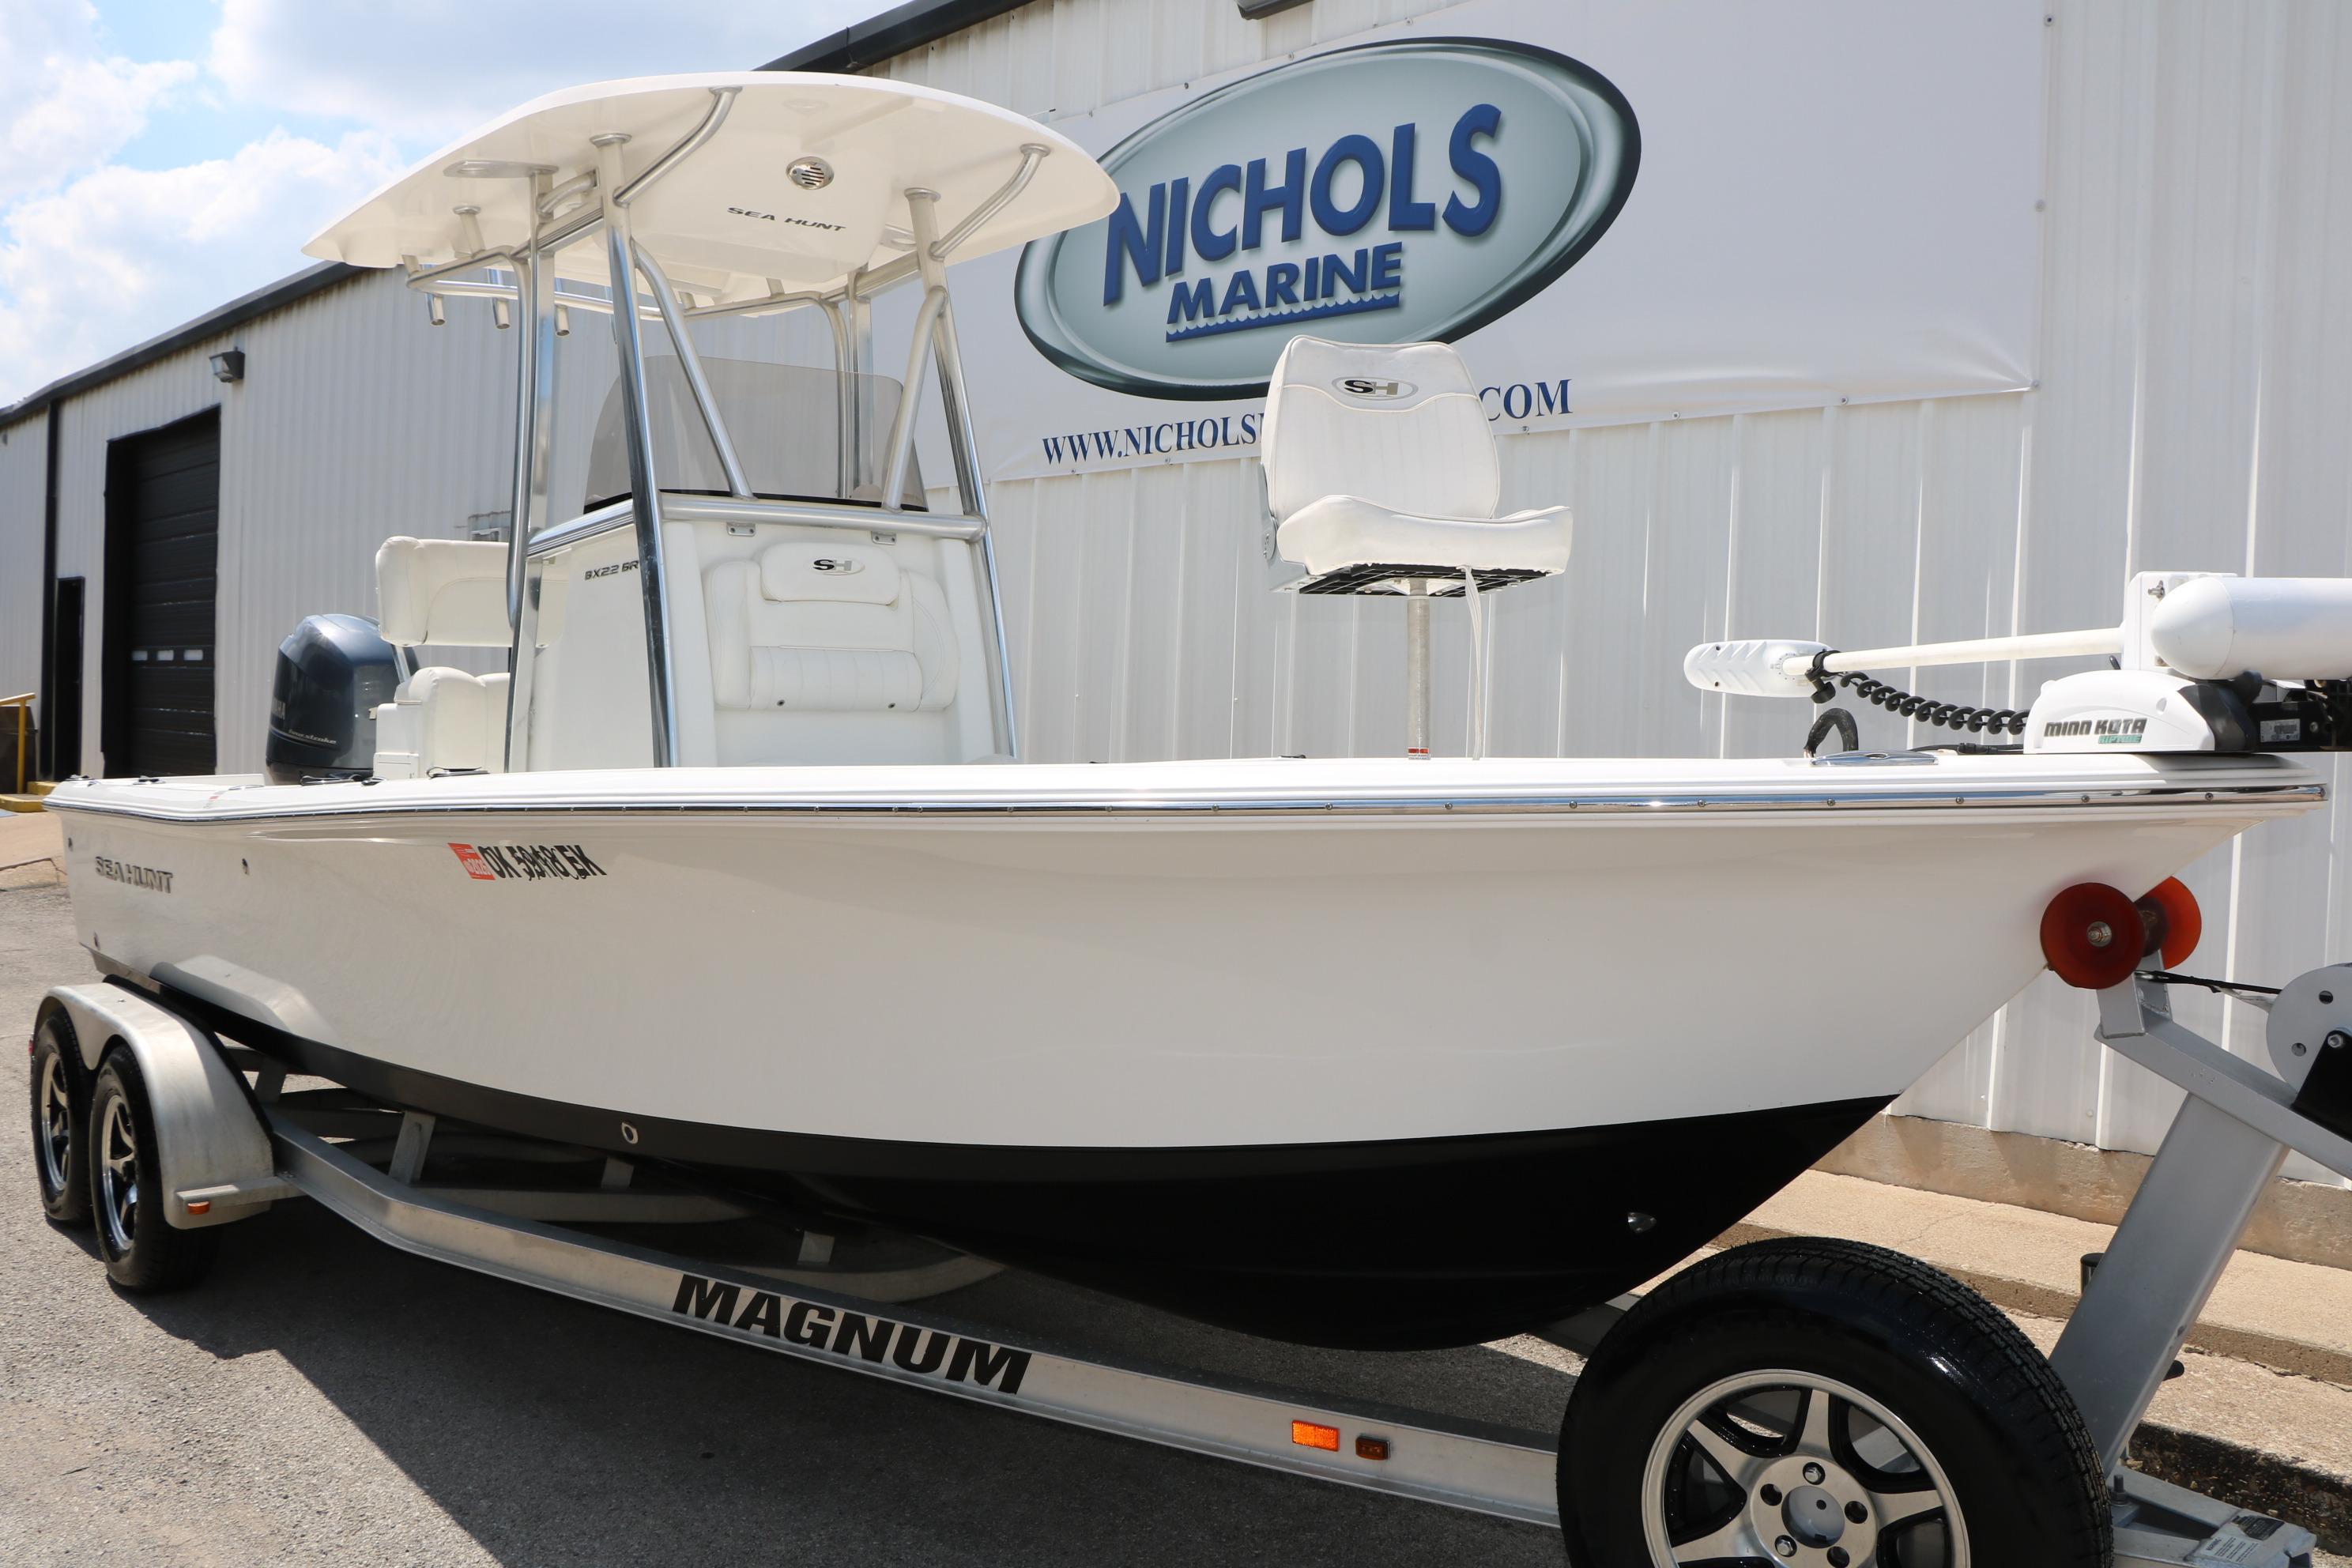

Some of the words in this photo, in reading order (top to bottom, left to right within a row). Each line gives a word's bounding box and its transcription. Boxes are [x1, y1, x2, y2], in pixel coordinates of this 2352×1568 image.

[727, 207, 775, 221] SEA
[784, 217, 846, 232] HUNT
[1103, 103, 1502, 306] NICHOLS
[1167, 242, 1404, 324] MARINE
[1344, 379, 1399, 396] SH
[584, 564, 620, 580] BX22
[2043, 719, 2093, 737] MINN
[2094, 718, 2147, 735] KOTA
[95, 856, 126, 884] SEA
[125, 863, 173, 894] HUNT
[672, 1274, 1032, 1394] MAGNUM
